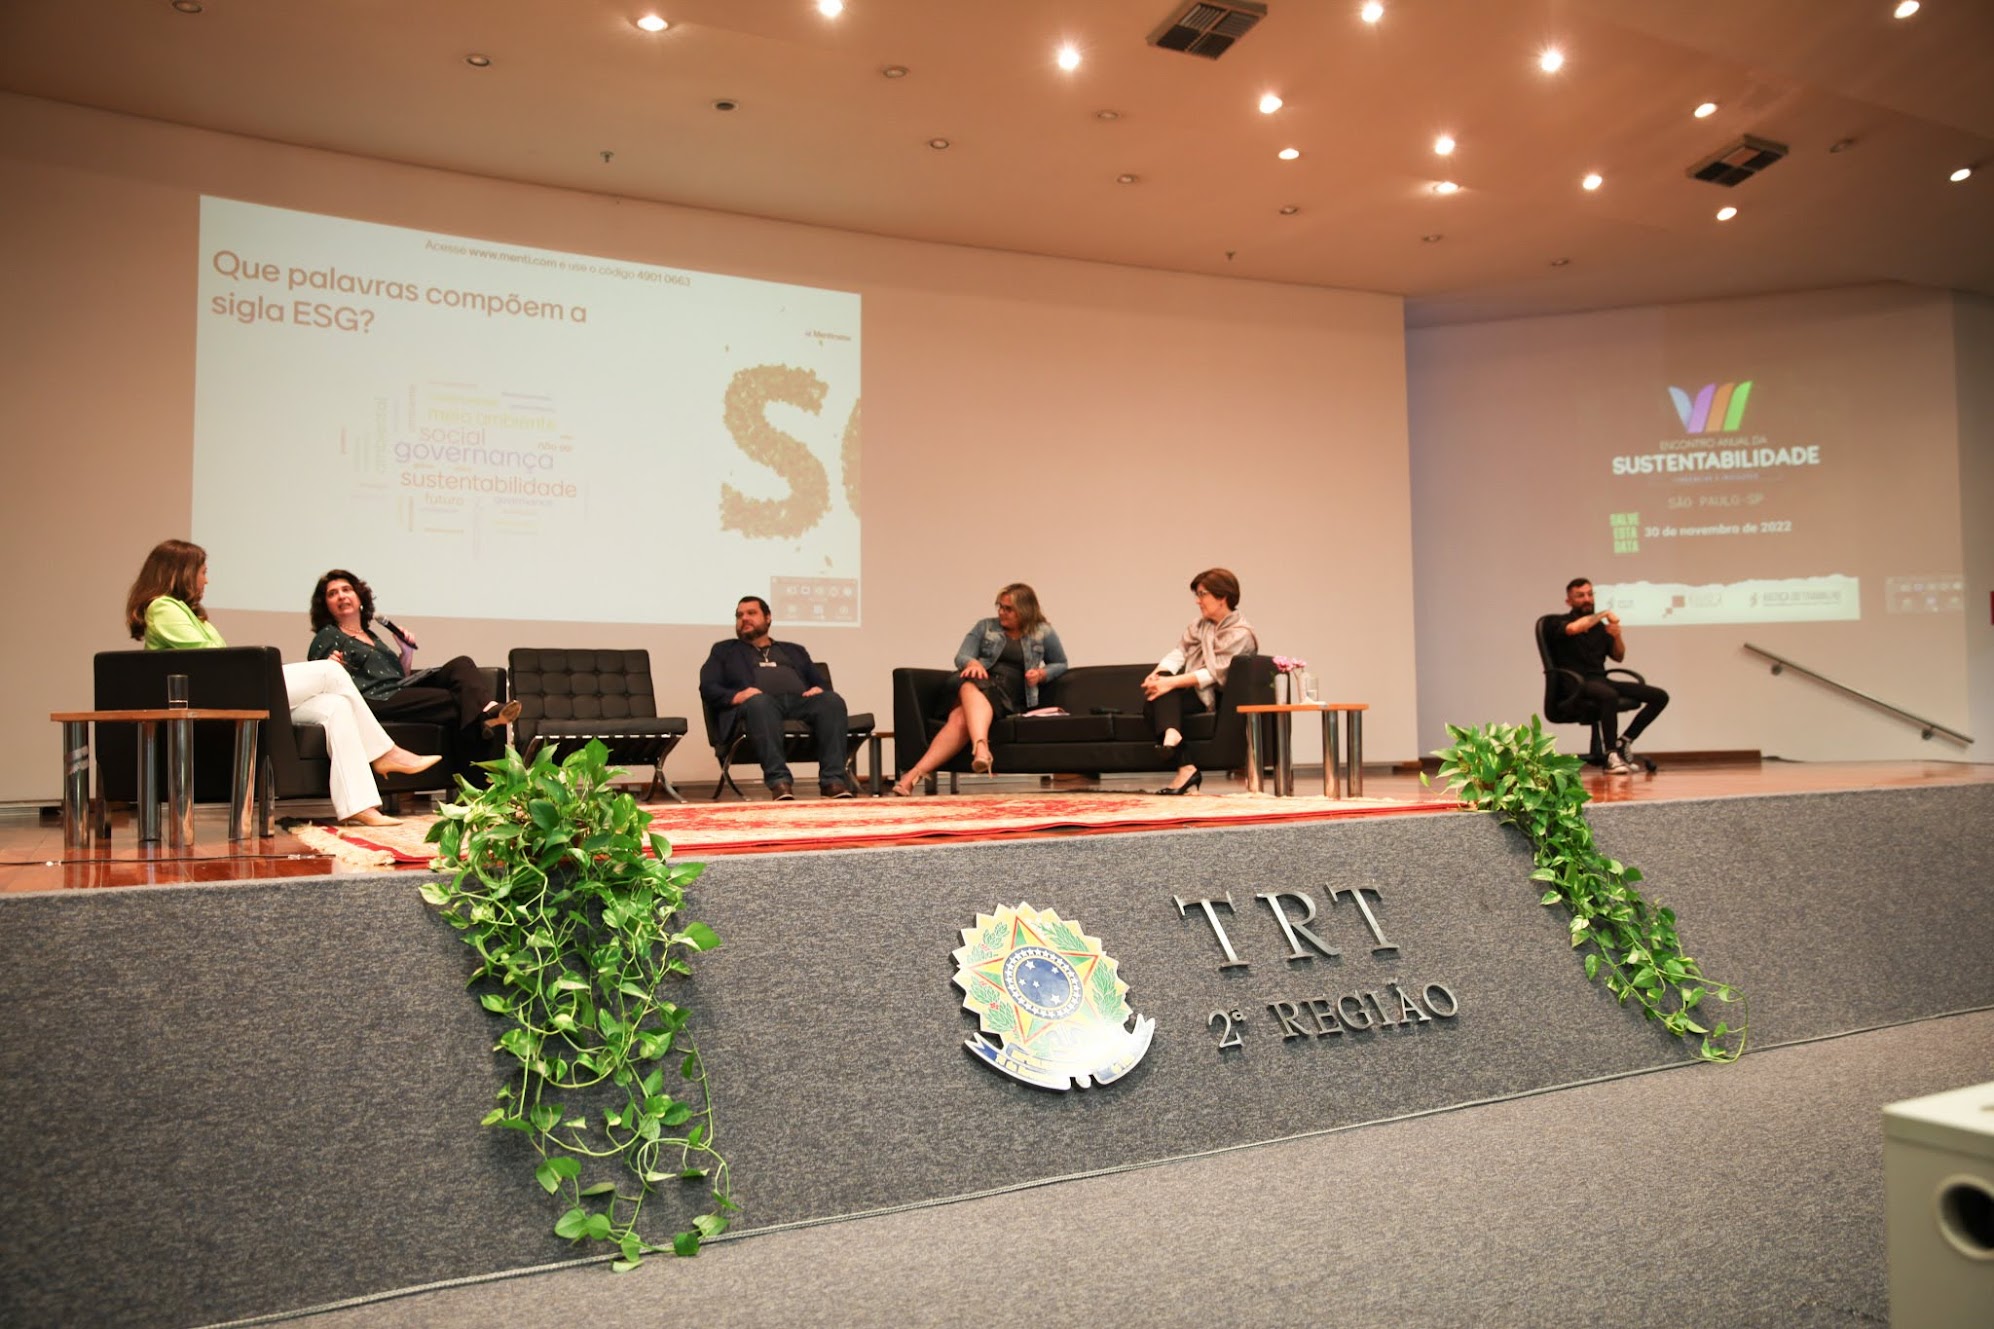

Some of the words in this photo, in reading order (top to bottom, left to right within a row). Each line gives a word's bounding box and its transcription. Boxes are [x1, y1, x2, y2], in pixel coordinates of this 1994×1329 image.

[468, 248, 557, 268] www.menti.com
[213, 250, 281, 283] Que
[288, 265, 419, 301] palavras
[426, 285, 564, 321] compõem
[571, 306, 588, 323] a
[211, 292, 285, 324] sigla
[293, 299, 376, 333] ESG?
[419, 426, 486, 446] social
[394, 440, 554, 474] governança
[1612, 445, 1820, 475] SUSTENTABILIDADE
[400, 471, 577, 498] sustentabilidade
[1644, 526, 1660, 537] 30
[1662, 525, 1677, 537] de
[1679, 523, 1740, 536] novembro
[1742, 522, 1757, 534] de
[1760, 520, 1792, 533] 2022
[1172, 881, 1399, 970] TRT
[1267, 979, 1459, 1038] REGIÃO
